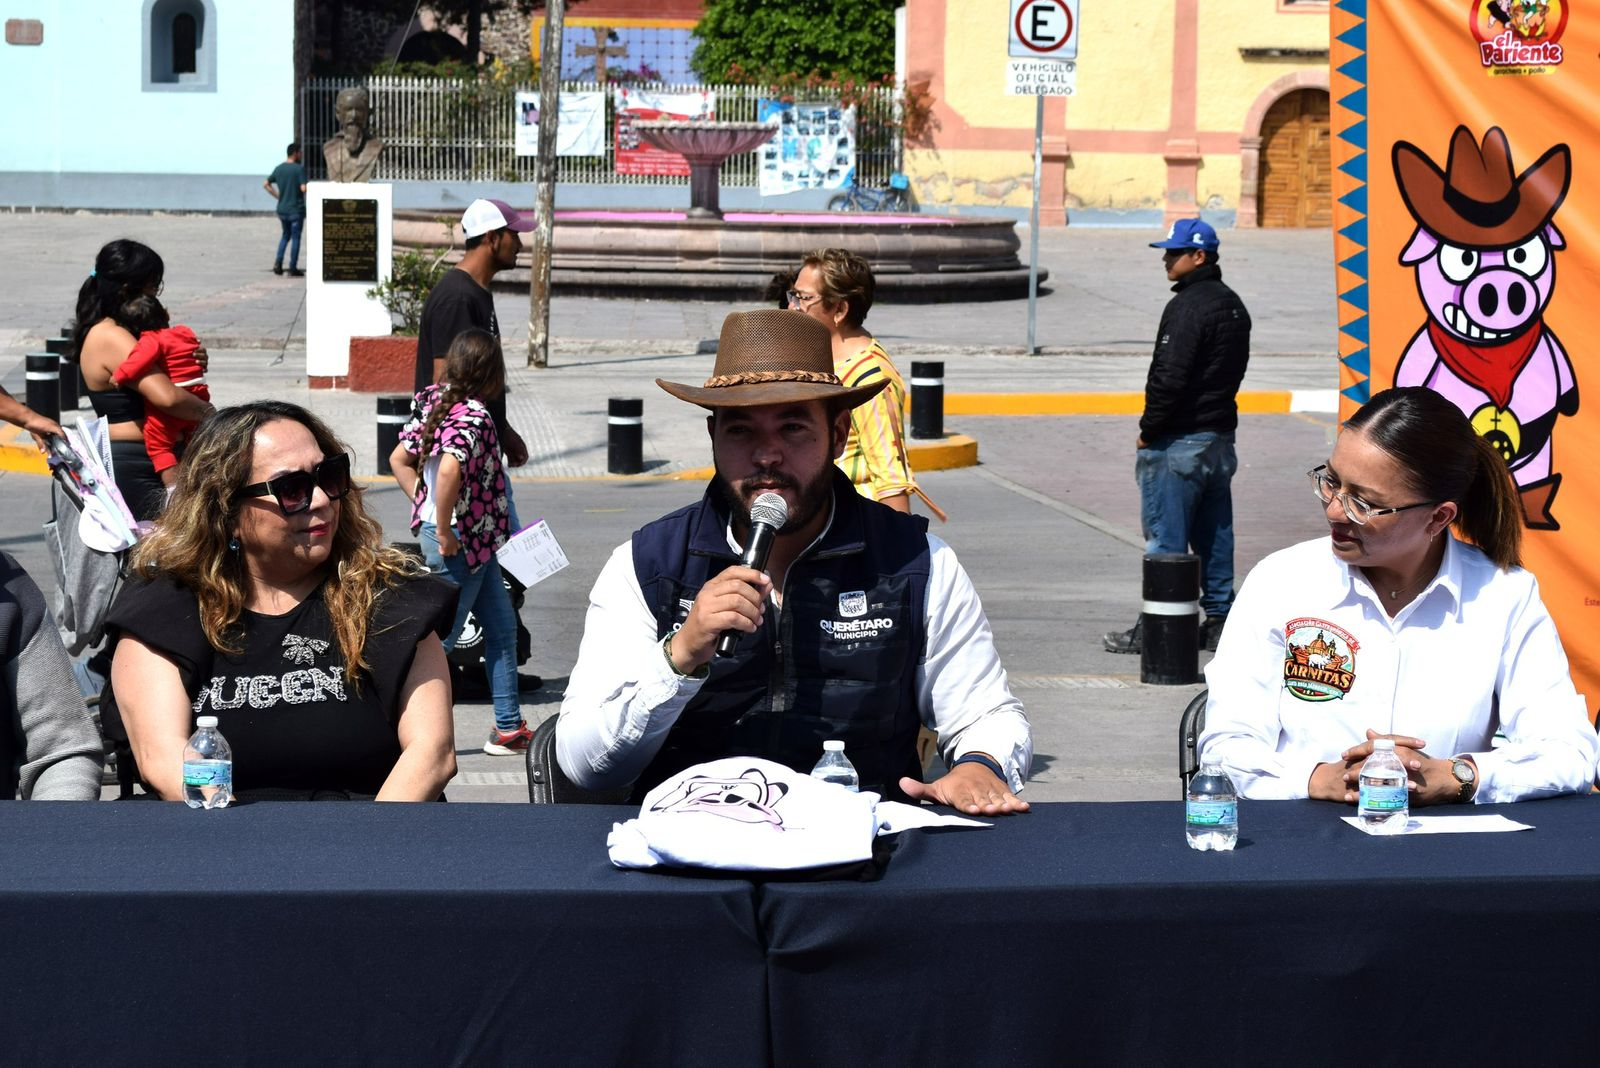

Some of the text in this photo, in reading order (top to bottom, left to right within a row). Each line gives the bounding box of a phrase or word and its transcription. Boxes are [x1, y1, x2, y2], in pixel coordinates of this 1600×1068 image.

[1031, 5, 1056, 42] E
[1494, 31, 1512, 47] el
[1481, 41, 1562, 65] Pariente
[1012, 63, 1074, 73] VEHICULO
[1016, 73, 1067, 84] OFICIAL
[1015, 84, 1073, 95] DELEGADO
[820, 618, 893, 634] QUERÉTARO
[834, 630, 878, 640] MUNICIPIO
[1285, 660, 1352, 689] CARNITAS
